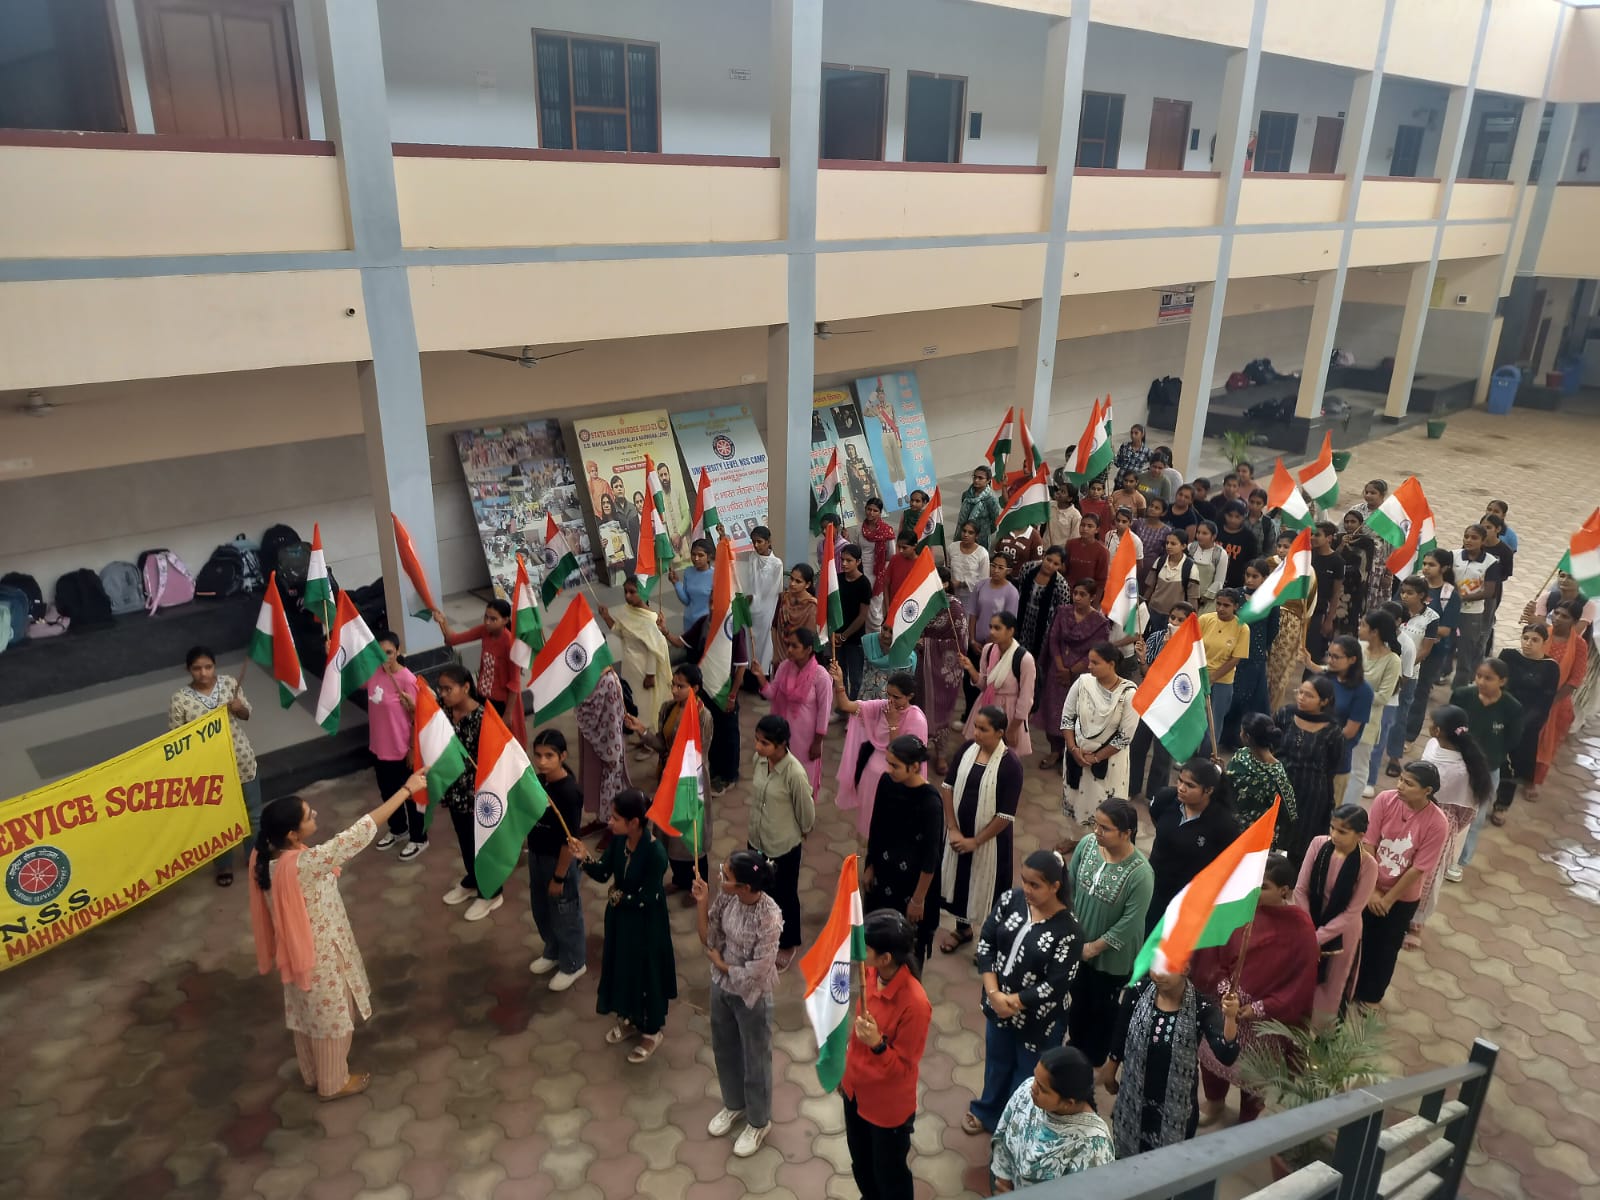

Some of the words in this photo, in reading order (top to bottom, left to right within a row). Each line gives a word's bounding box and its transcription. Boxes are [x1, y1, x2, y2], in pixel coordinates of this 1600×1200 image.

[723, 459, 739, 470] LEVEL
[740, 457, 751, 467] NSS
[751, 454, 766, 465] CAMP
[163, 734, 193, 762] BUT
[196, 717, 222, 744] YOU
[105, 774, 225, 818] SCHEME
[155, 822, 246, 885] NARWANA
